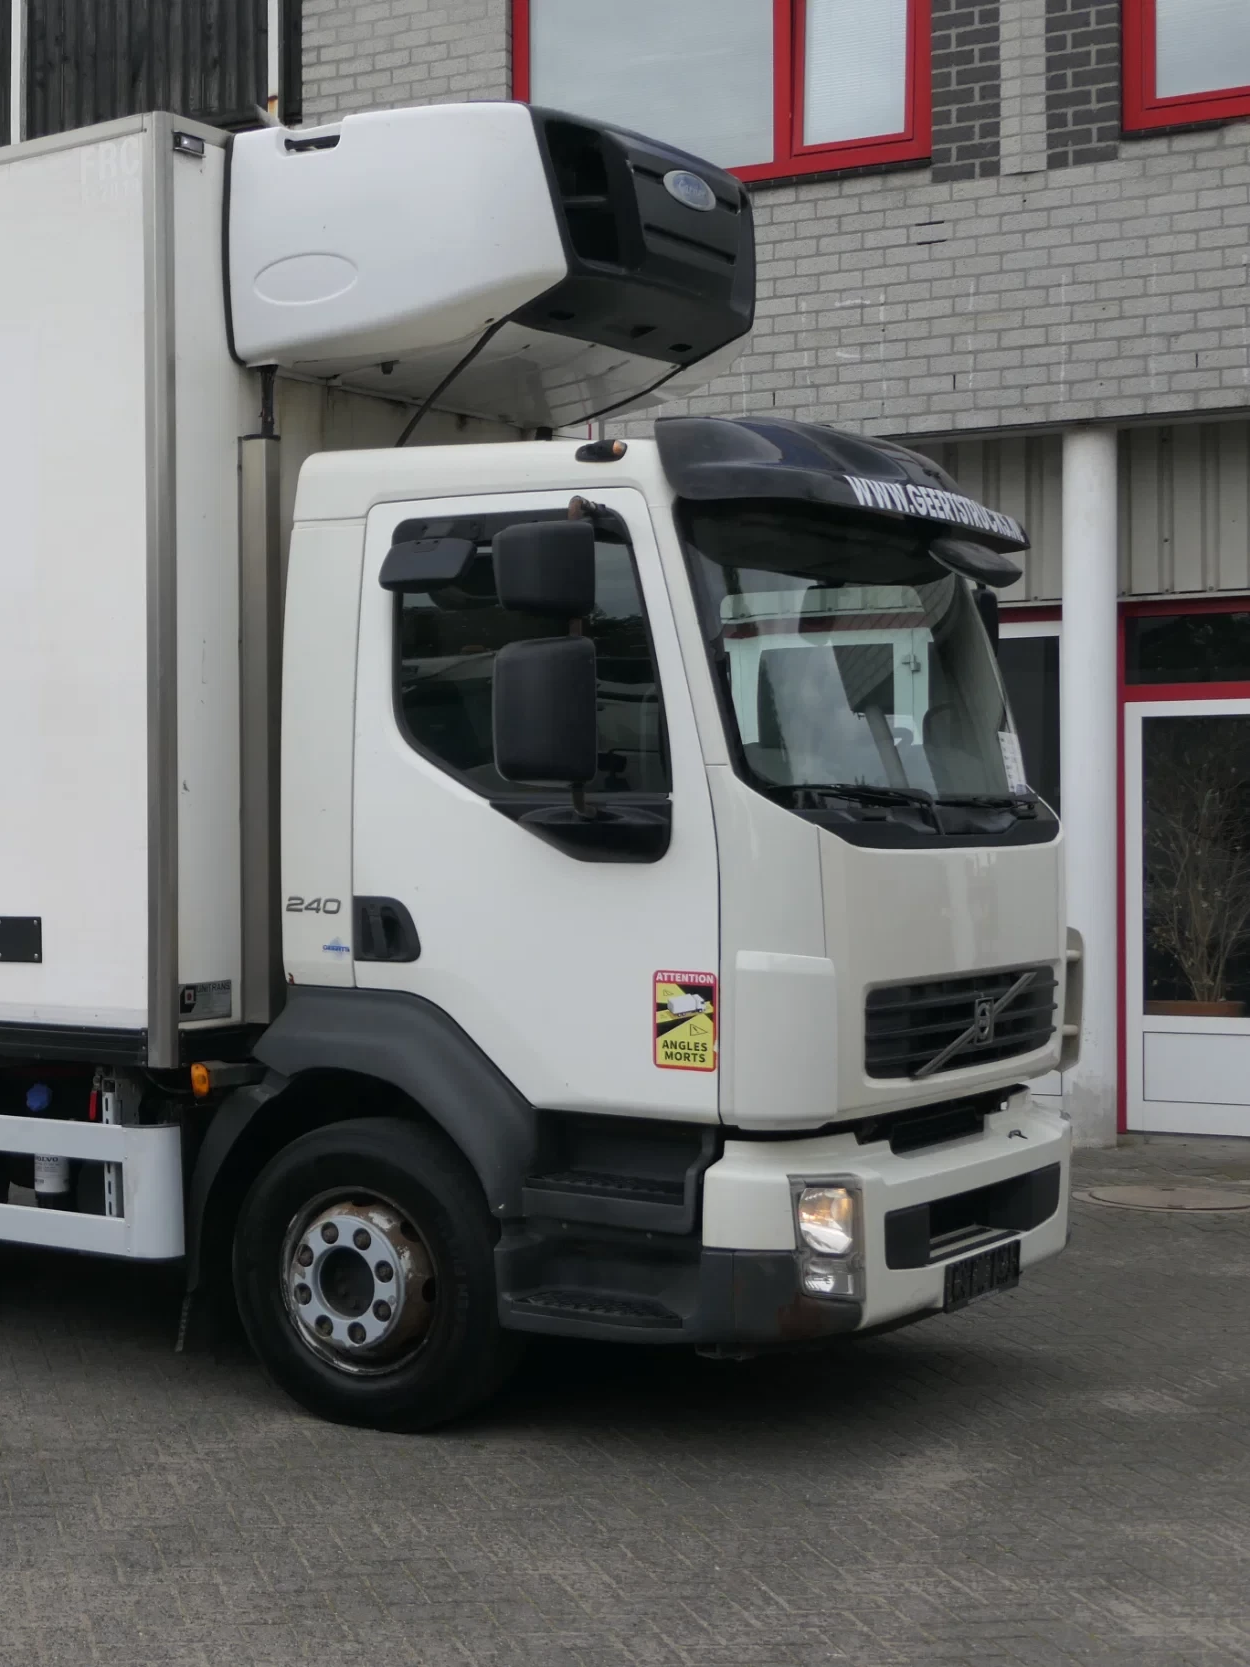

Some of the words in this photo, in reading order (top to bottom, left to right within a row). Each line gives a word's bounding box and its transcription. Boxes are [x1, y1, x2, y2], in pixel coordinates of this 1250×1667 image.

[286, 896, 341, 914] 240
[656, 972, 714, 984] ATTENTION
[662, 1039, 708, 1052] ANGLES
[664, 1051, 706, 1063] MORTS
